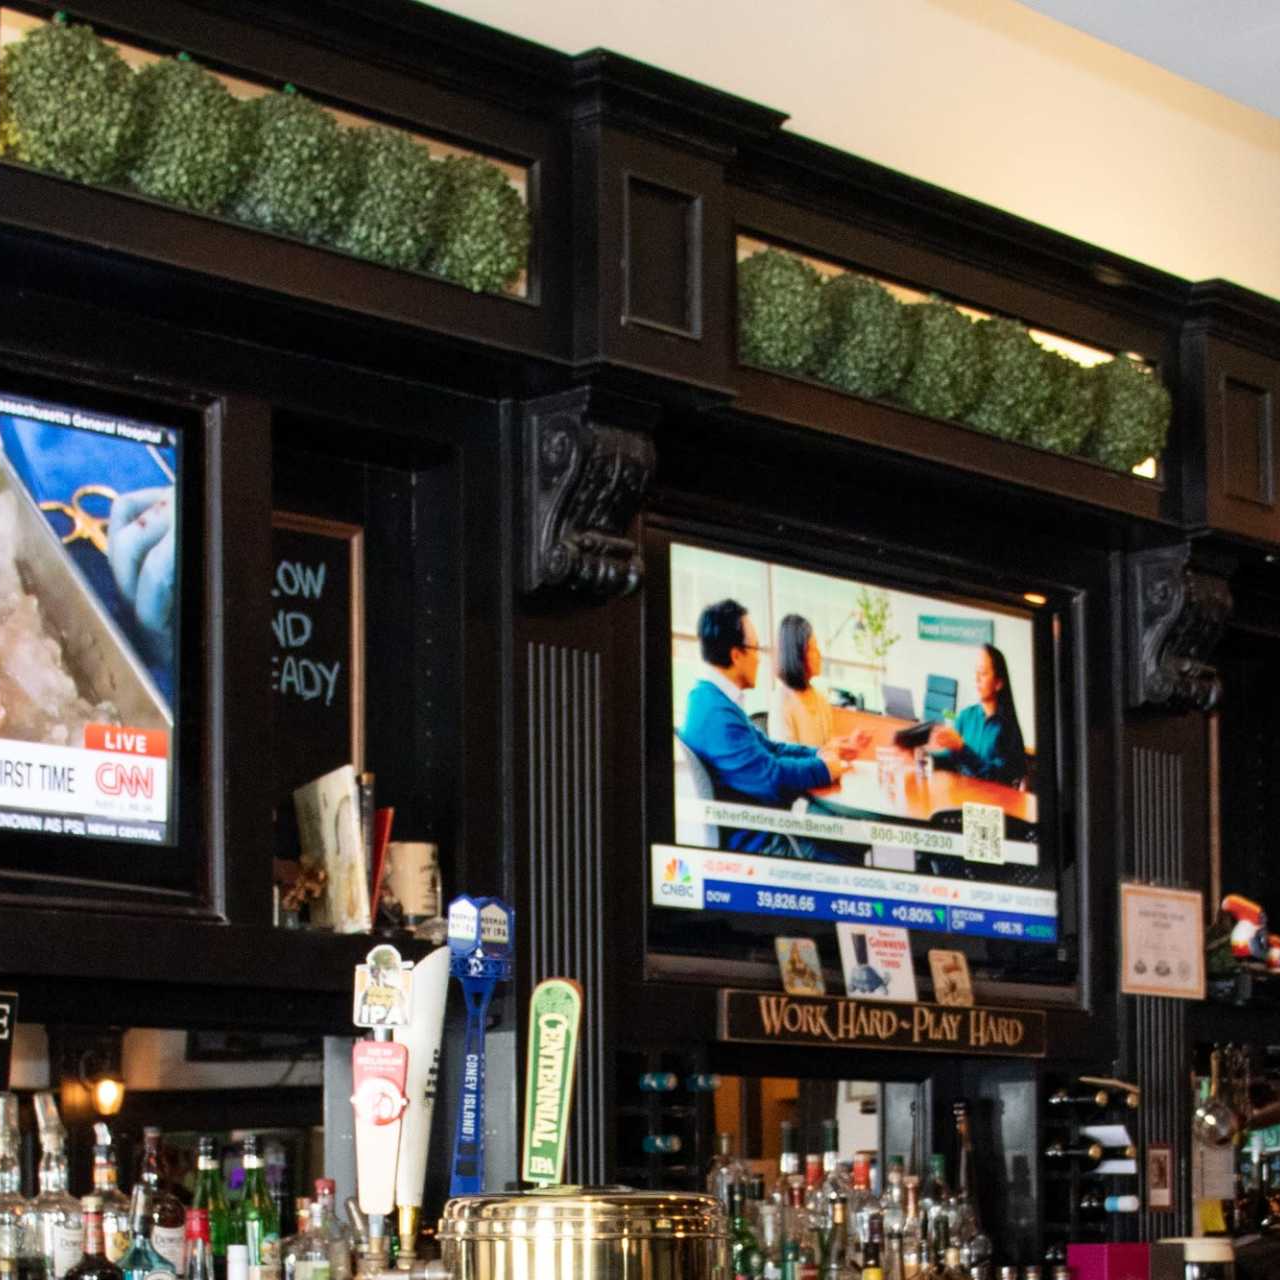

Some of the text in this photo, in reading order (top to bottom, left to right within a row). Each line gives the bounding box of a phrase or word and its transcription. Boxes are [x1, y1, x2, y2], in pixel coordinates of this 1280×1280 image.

[72, 412, 115, 435] General
[117, 422, 162, 445] Hospital
[272, 560, 327, 599] OW
[104, 731, 147, 753] LIVE
[40, 764, 76, 794] TIME
[96, 762, 154, 799] CNN
[44, 817, 62, 833] AS
[88, 823, 162, 841] NEWS CENTRAL
[661, 883, 694, 898] CNBC
[706, 889, 731, 903] DOW
[830, 900, 872, 918] +314.53
[892, 906, 934, 923] +0.80%
[870, 936, 906, 950] GUINNESS
[361, 1004, 404, 1024] IPA
[758, 996, 837, 1041] WORK
[970, 1010, 1024, 1046] HARD
[464, 1054, 478, 1090] CONEY
[531, 1012, 568, 1149] CENTENNIAL
[531, 1156, 555, 1175] IPA
